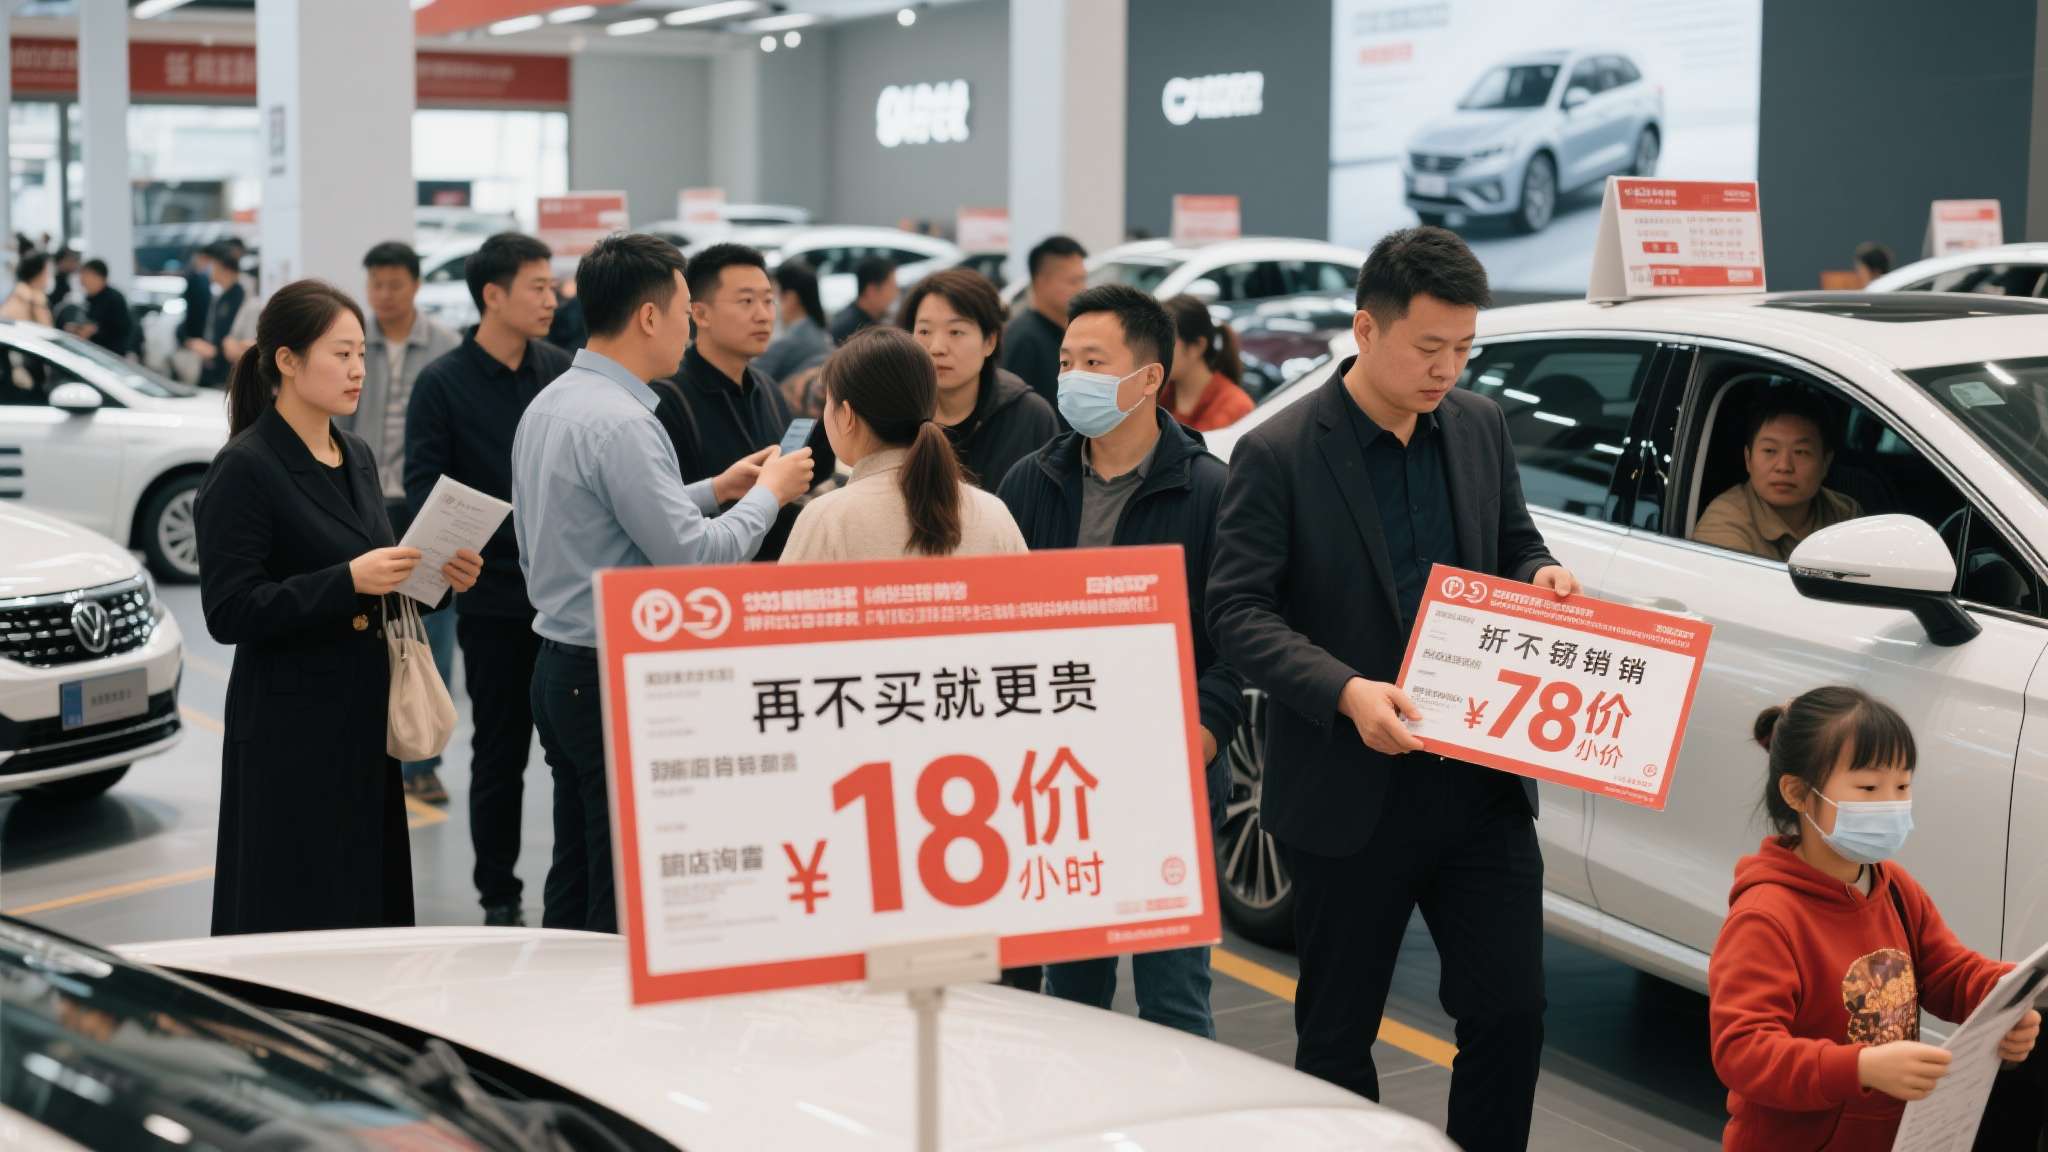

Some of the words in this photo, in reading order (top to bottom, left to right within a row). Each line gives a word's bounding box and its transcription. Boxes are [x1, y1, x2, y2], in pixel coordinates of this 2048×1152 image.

[752, 660, 1098, 733] 再不买就更贵
[1575, 738, 1623, 769] 小价
[1019, 851, 1104, 901] 小时
